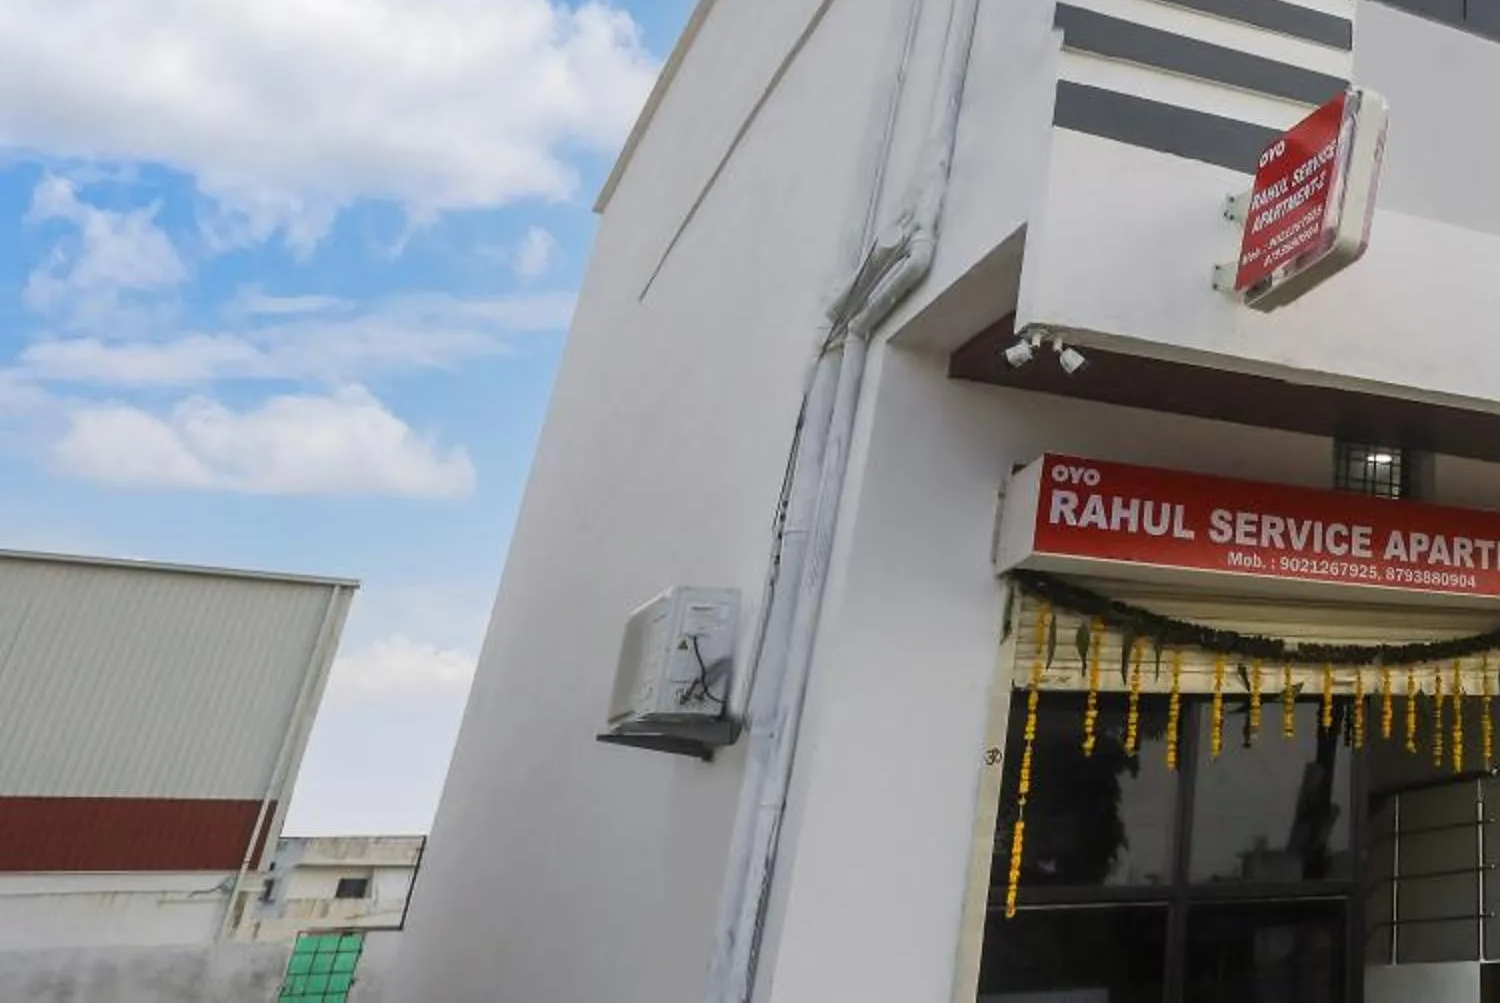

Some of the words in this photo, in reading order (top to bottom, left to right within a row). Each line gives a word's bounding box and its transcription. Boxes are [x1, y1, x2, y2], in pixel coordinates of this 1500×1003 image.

[1260, 140, 1285, 168] OYO
[1251, 177, 1289, 211] RAHUL
[1051, 464, 1101, 486] OYO
[1049, 489, 1195, 541] RAHUL
[1208, 507, 1373, 559] SERVICE
[1227, 552, 1266, 569] Mob.
[1279, 555, 1382, 582] 9021267925,
[1385, 568, 1477, 589] 8793880904
